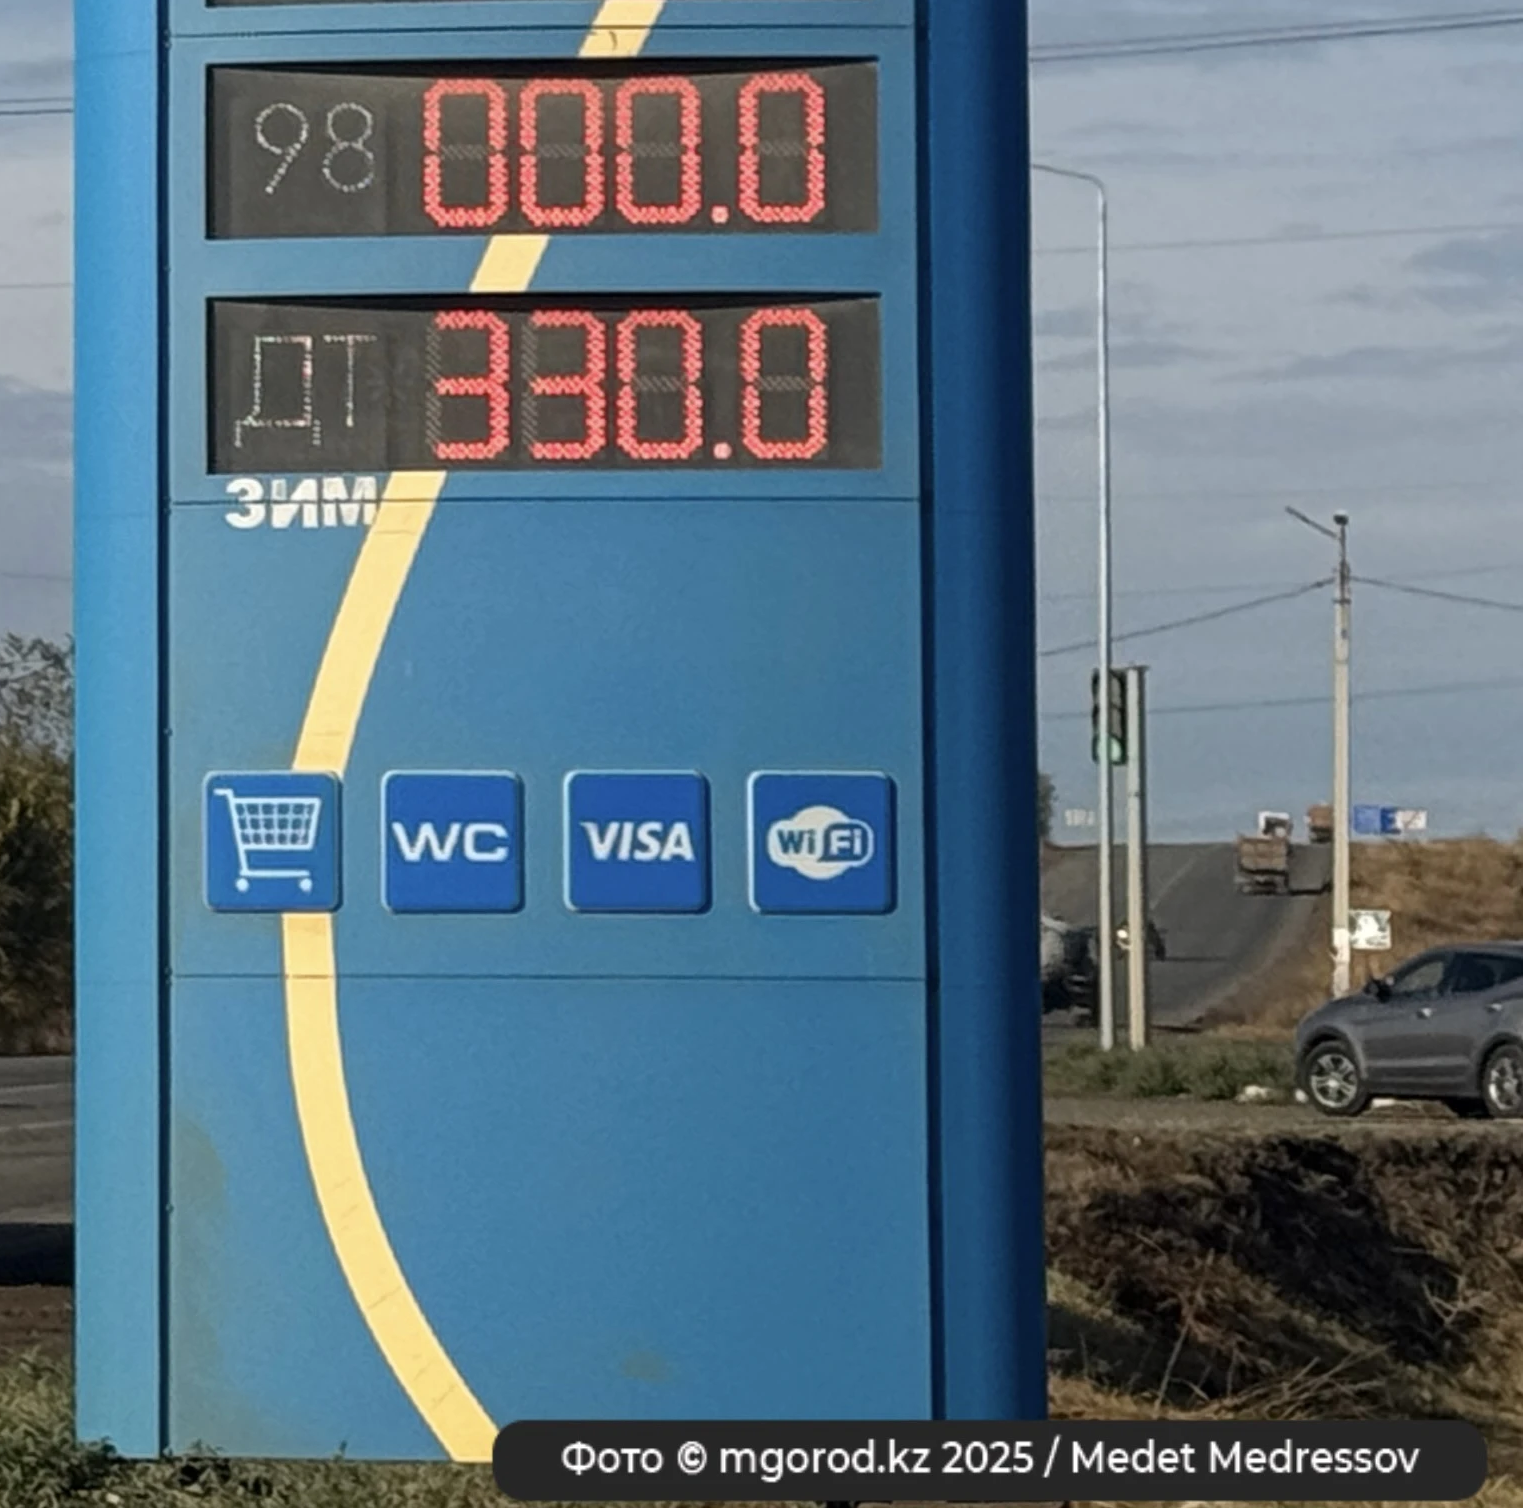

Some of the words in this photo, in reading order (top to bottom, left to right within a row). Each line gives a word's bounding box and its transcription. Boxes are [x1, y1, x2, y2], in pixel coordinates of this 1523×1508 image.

[254, 101, 377, 196] 98
[422, 72, 827, 230] 000.0
[233, 333, 378, 449] ДТ
[427, 307, 829, 462] 330.0
[391, 821, 510, 863] WC
[579, 821, 696, 863] VISA
